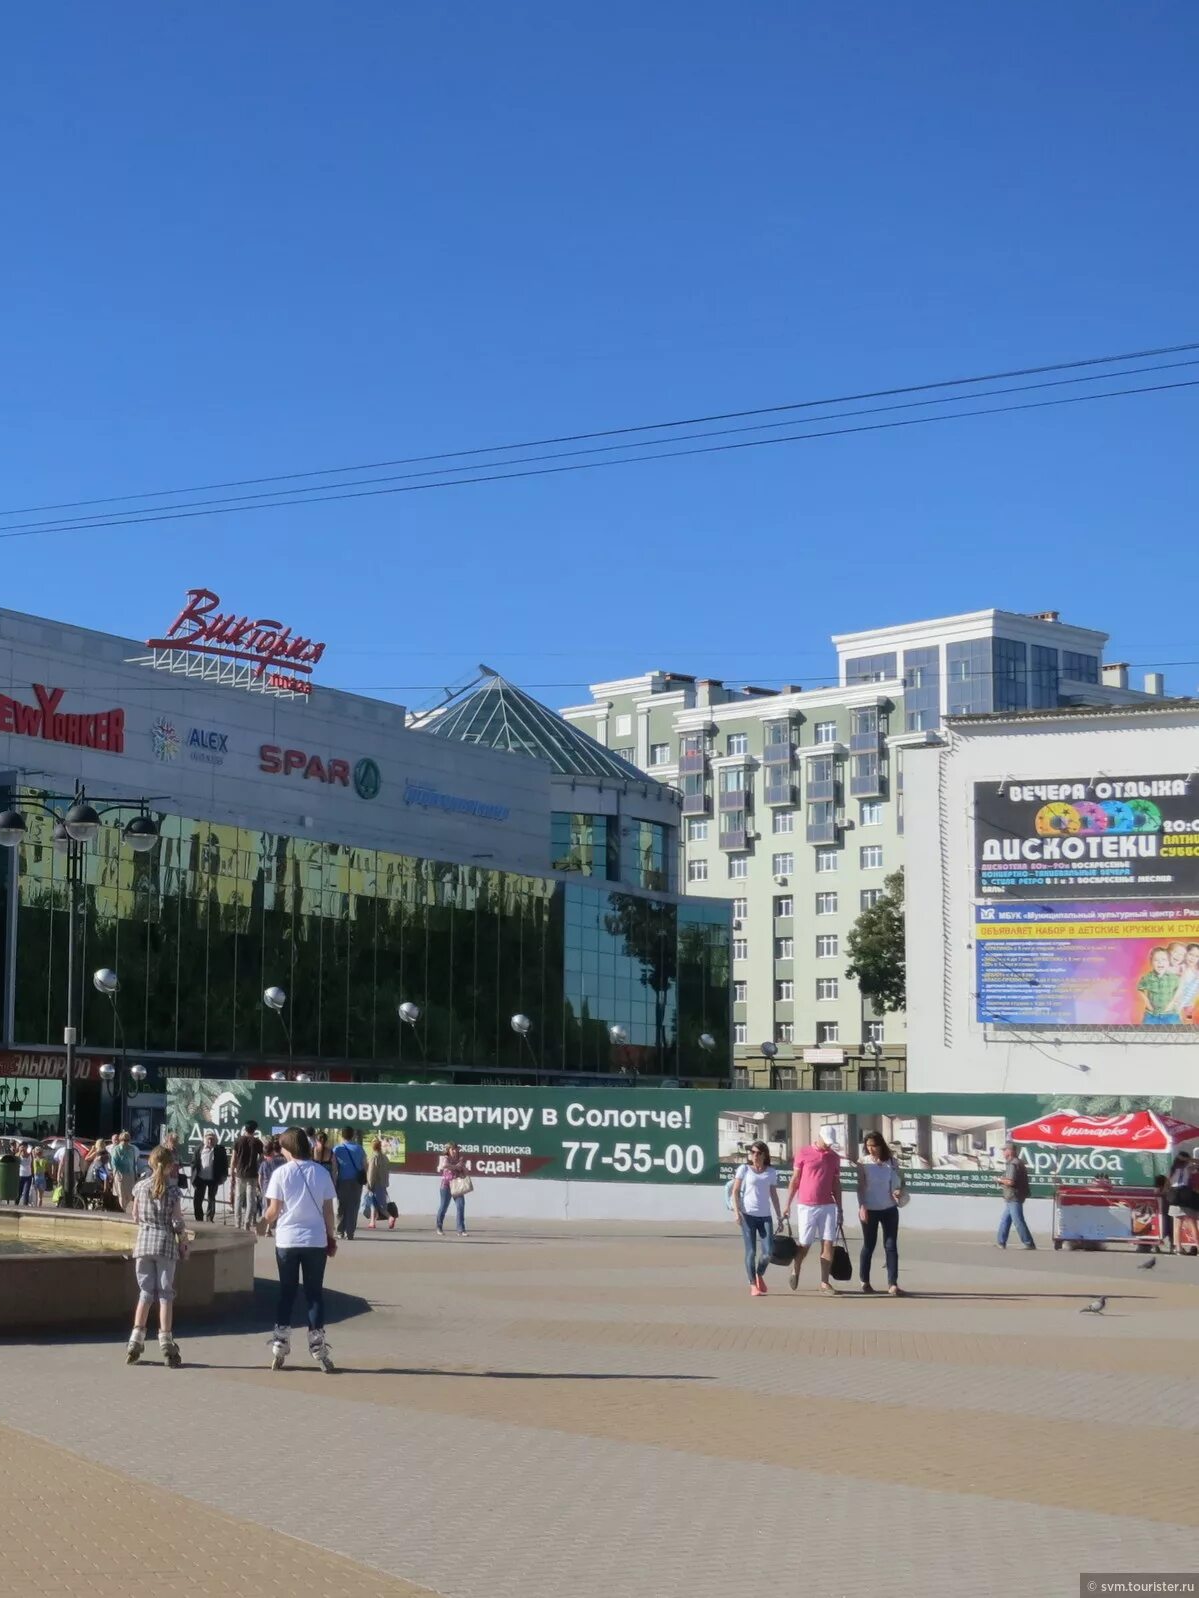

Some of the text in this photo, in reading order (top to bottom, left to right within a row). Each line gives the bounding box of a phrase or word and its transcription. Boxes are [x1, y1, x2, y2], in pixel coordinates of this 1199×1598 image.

[146, 588, 326, 677] Виктория
[189, 728, 228, 752] ALEX
[259, 745, 350, 787] SPAR
[1009, 780, 1186, 801] ВЕЧЕРА ОТДЫХА
[982, 834, 1157, 860] ДИСКОТЕКИ
[981, 926, 1032, 935] ОБЪЯВЛЯЕТ
[1035, 926, 1066, 934] НАБОР
[1078, 926, 1120, 935] ДЕТСКИЕ
[1123, 926, 1164, 934] КРУЖКИ
[264, 1096, 692, 1131] Купи новую квартиру в Солотче!
[482, 1144, 531, 1156] прописка
[562, 1141, 705, 1174] 77-55-00
[476, 1158, 521, 1174] сдан!
